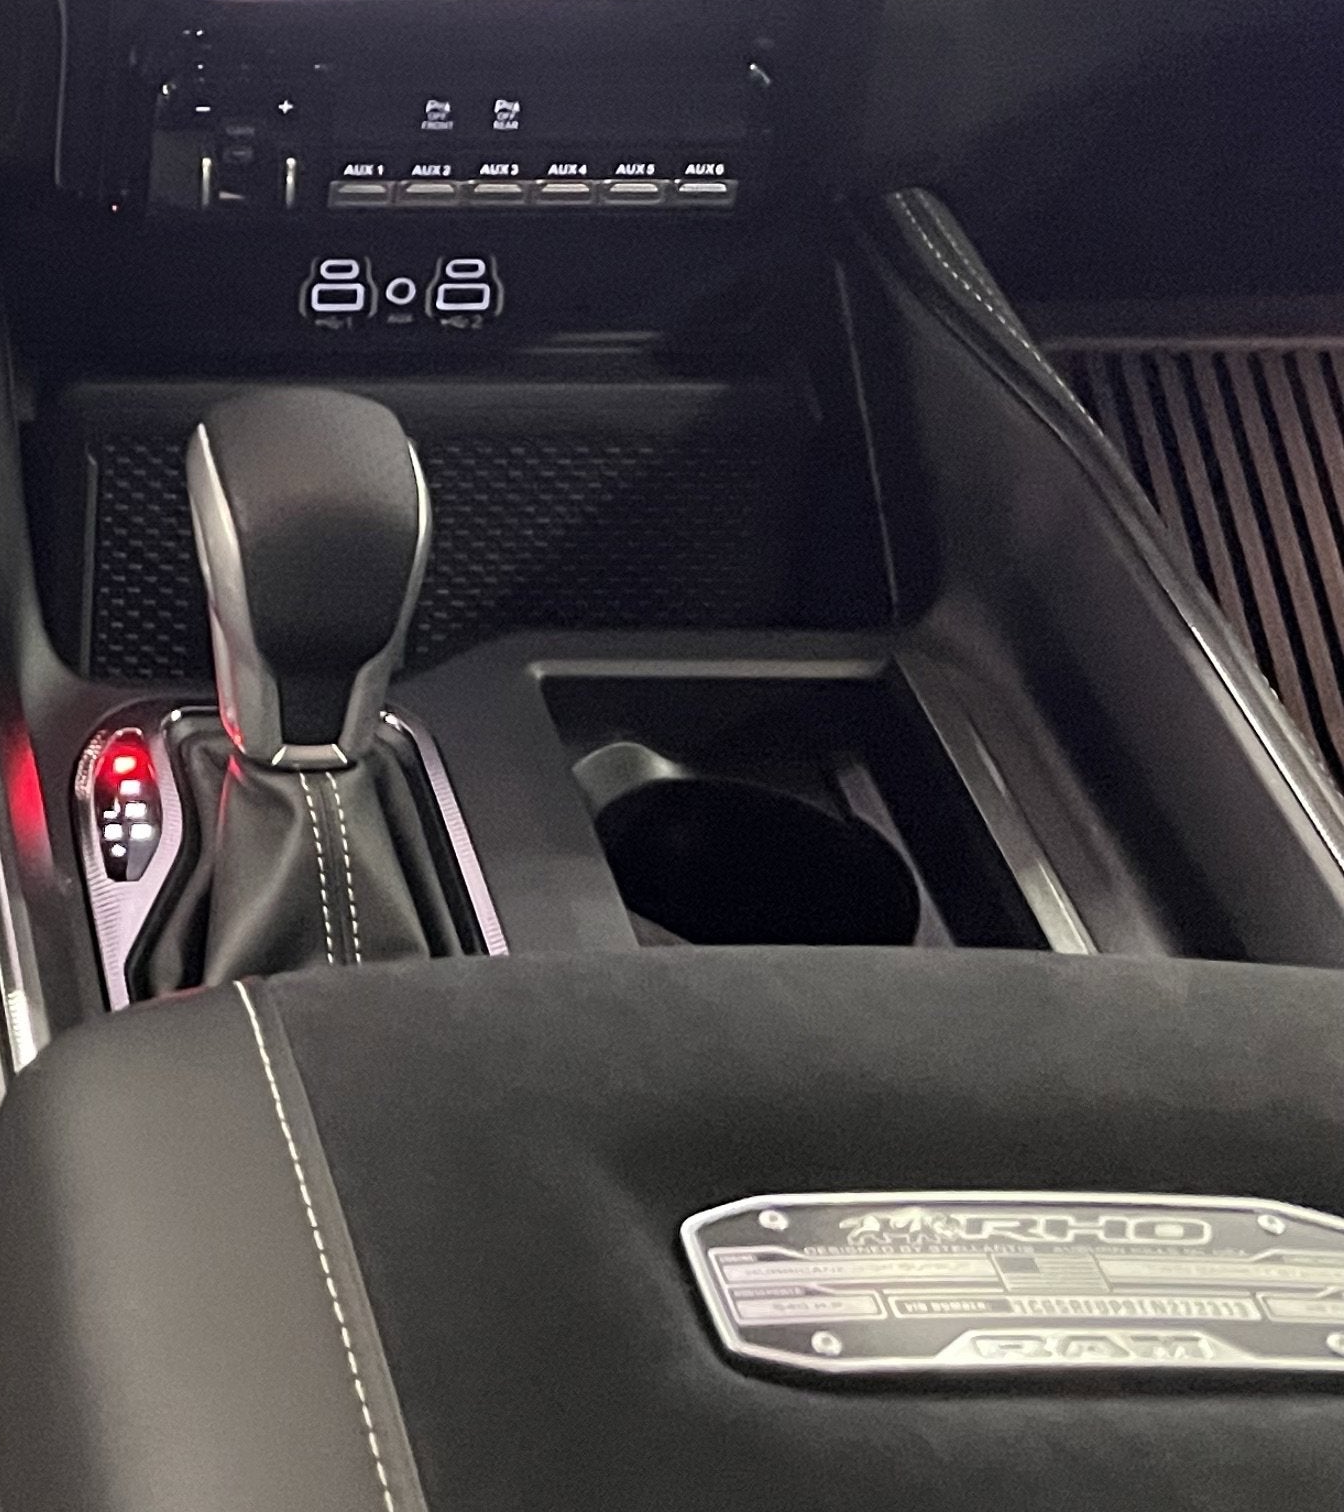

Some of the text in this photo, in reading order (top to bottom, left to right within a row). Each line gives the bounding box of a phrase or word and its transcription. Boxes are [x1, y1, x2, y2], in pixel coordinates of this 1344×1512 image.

[343, 164, 374, 175] AUX
[412, 165, 441, 176] AUX
[479, 164, 510, 175] AUX
[547, 164, 578, 175] AUX
[615, 164, 646, 175] AUX
[684, 164, 715, 175] AUX
[950, 1214, 1212, 1245] RHO
[969, 1334, 1213, 1359] RAM
